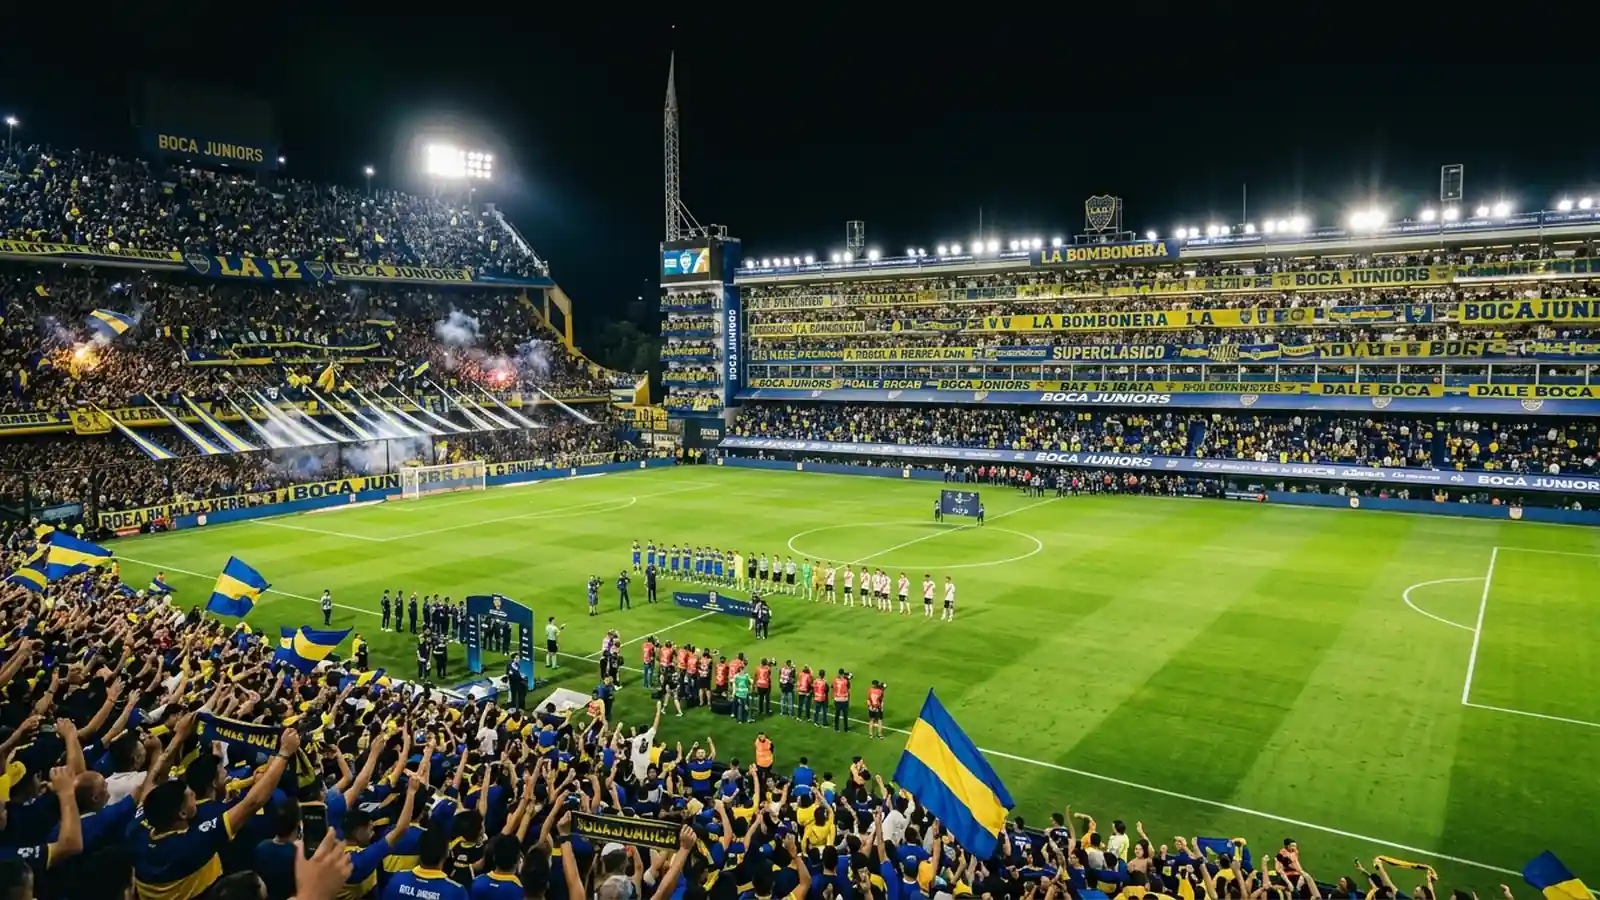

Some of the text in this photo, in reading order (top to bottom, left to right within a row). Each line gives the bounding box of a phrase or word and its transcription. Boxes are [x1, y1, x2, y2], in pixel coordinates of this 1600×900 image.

[158, 134, 264, 162] BOCA JUNIORS
[1041, 242, 1168, 263] LA BOMBONERA
[215, 256, 302, 278] LA 12
[1295, 268, 1430, 286] BOCA JUNIORS
[1465, 303, 1534, 320] BOCA
[1033, 316, 1054, 329] LA
[1061, 313, 1168, 328] BOMBONERA
[1040, 393, 1171, 404] BOCA JUNIORS
[1322, 384, 1431, 396] DALE BOCA
[1477, 386, 1593, 397] DALE BOCA
[1478, 475, 1527, 486] BOCA
[293, 480, 355, 499] BOCA
